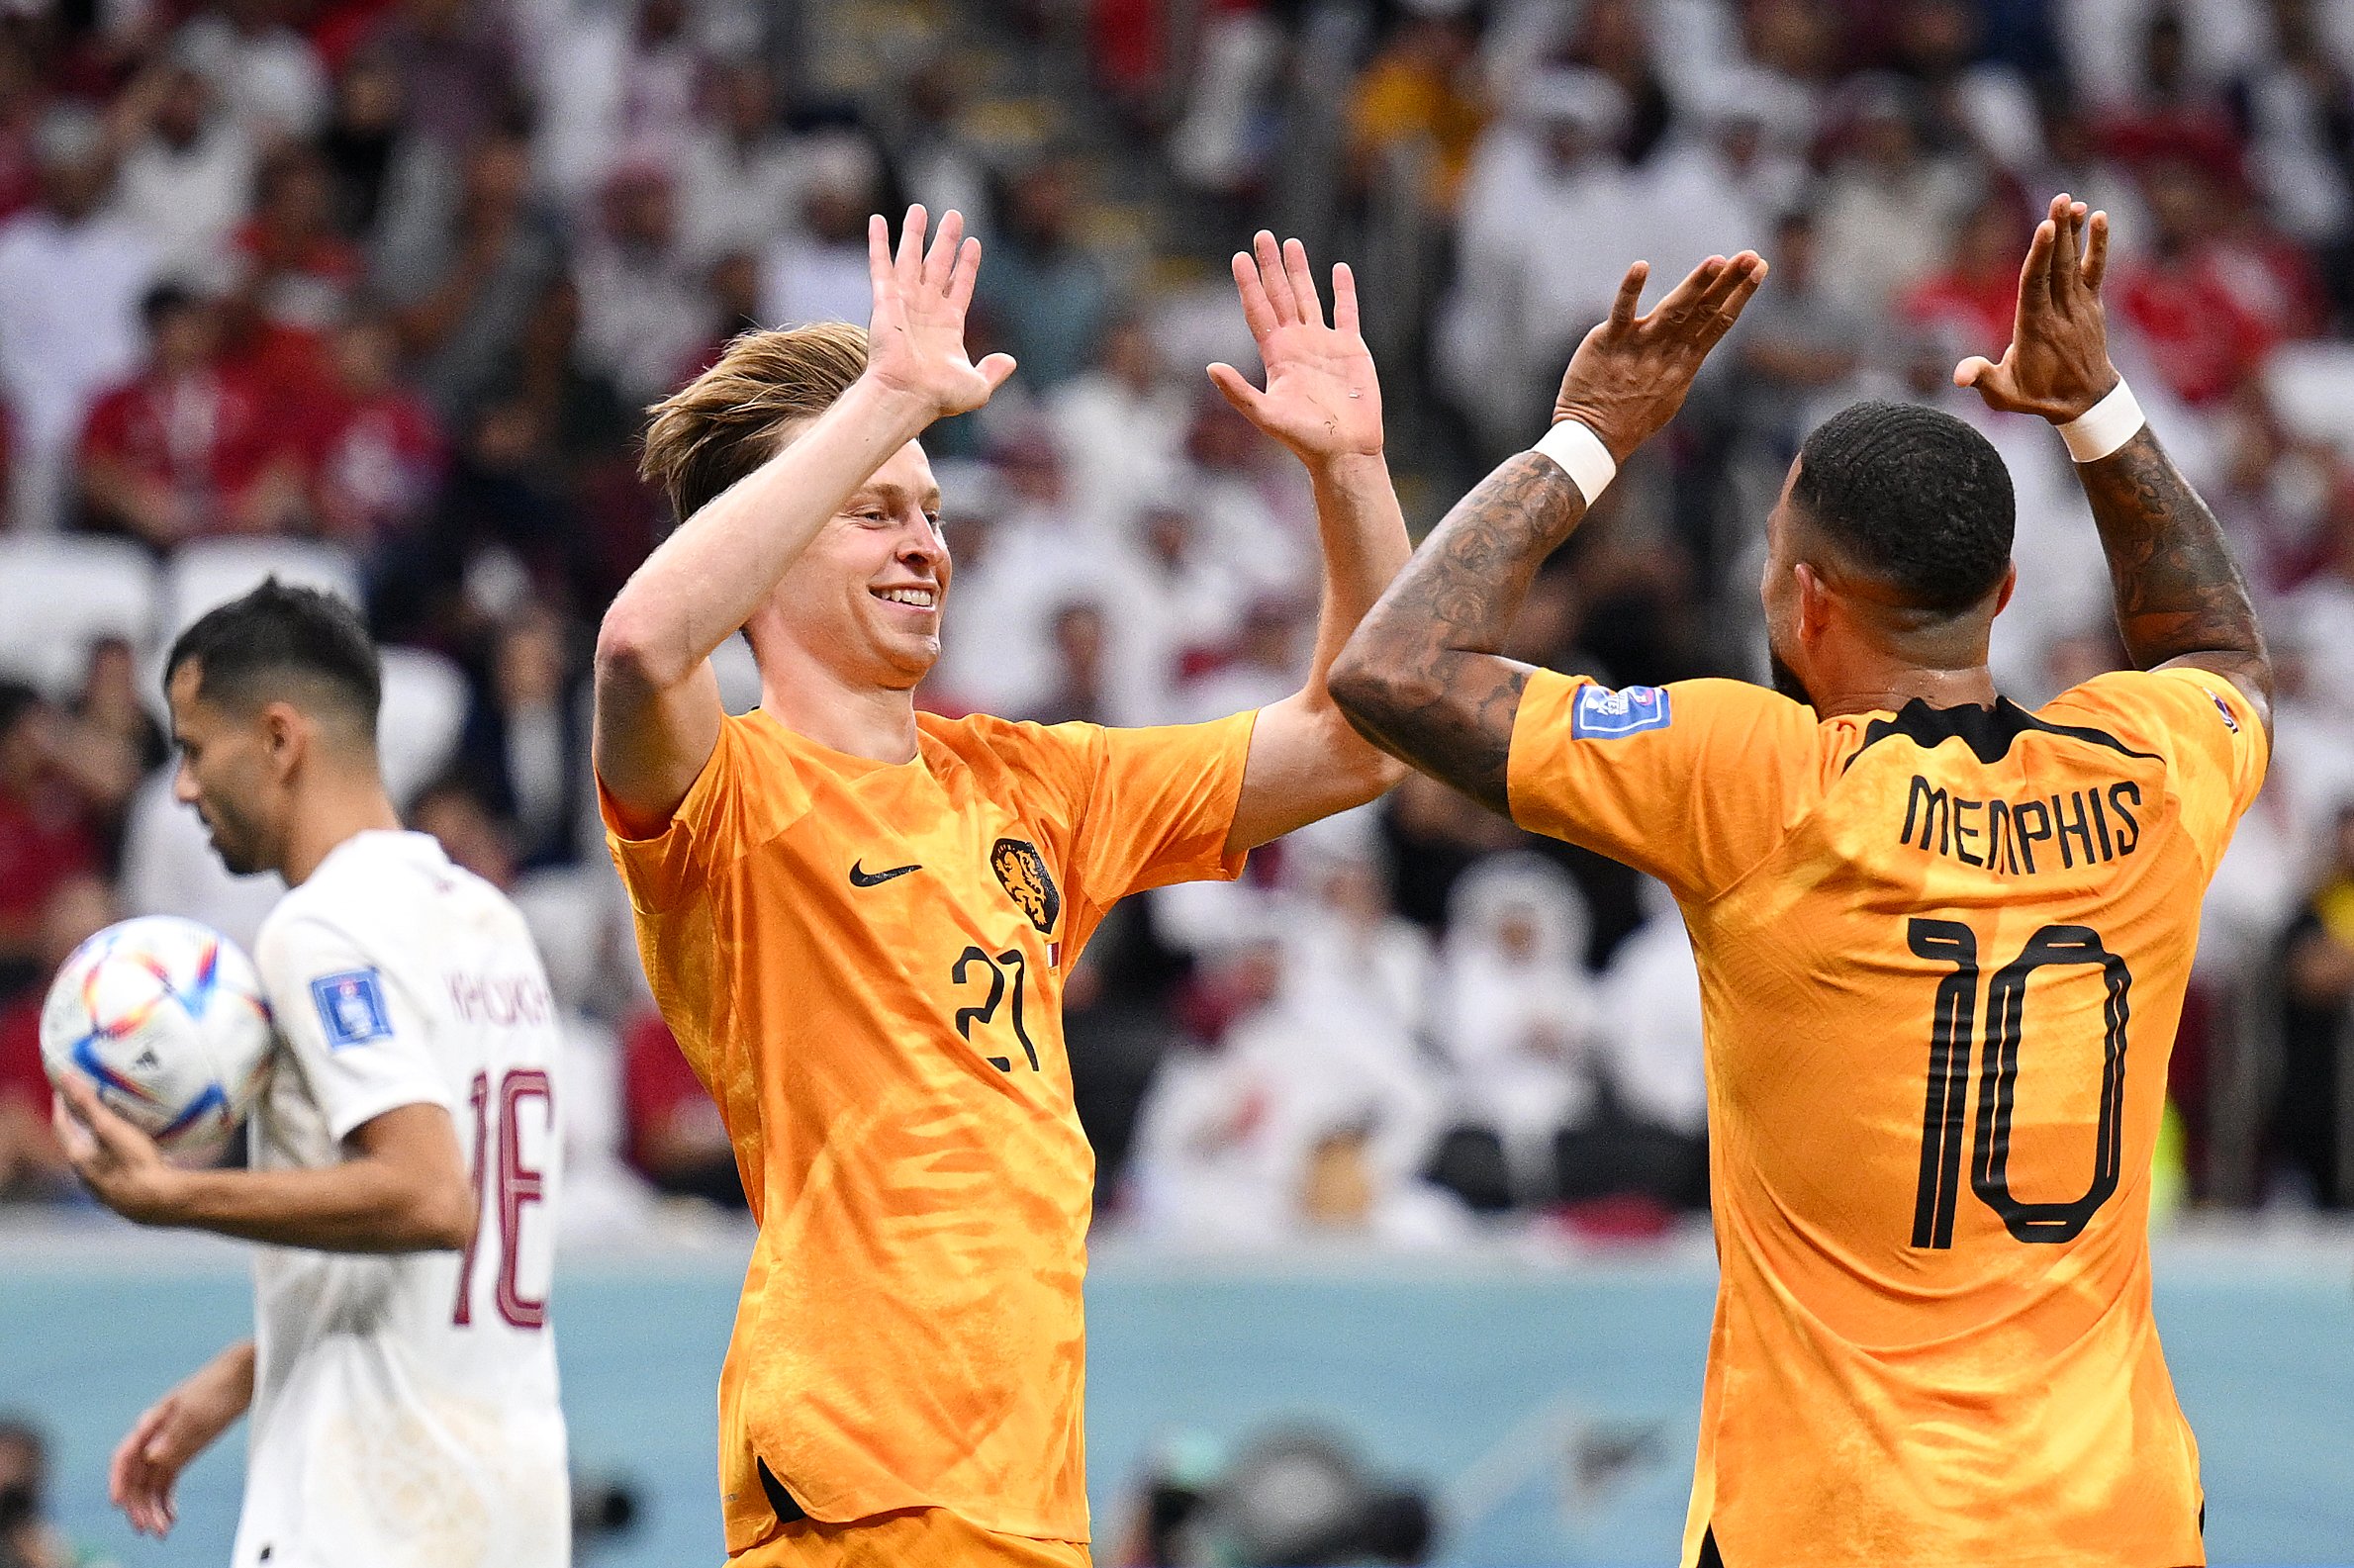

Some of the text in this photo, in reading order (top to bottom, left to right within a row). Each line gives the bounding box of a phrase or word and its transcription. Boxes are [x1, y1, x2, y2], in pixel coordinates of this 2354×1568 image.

[1900, 775, 2141, 876] MEMPHIS
[951, 946, 1039, 1072] 21
[1907, 917, 2132, 1249] 10
